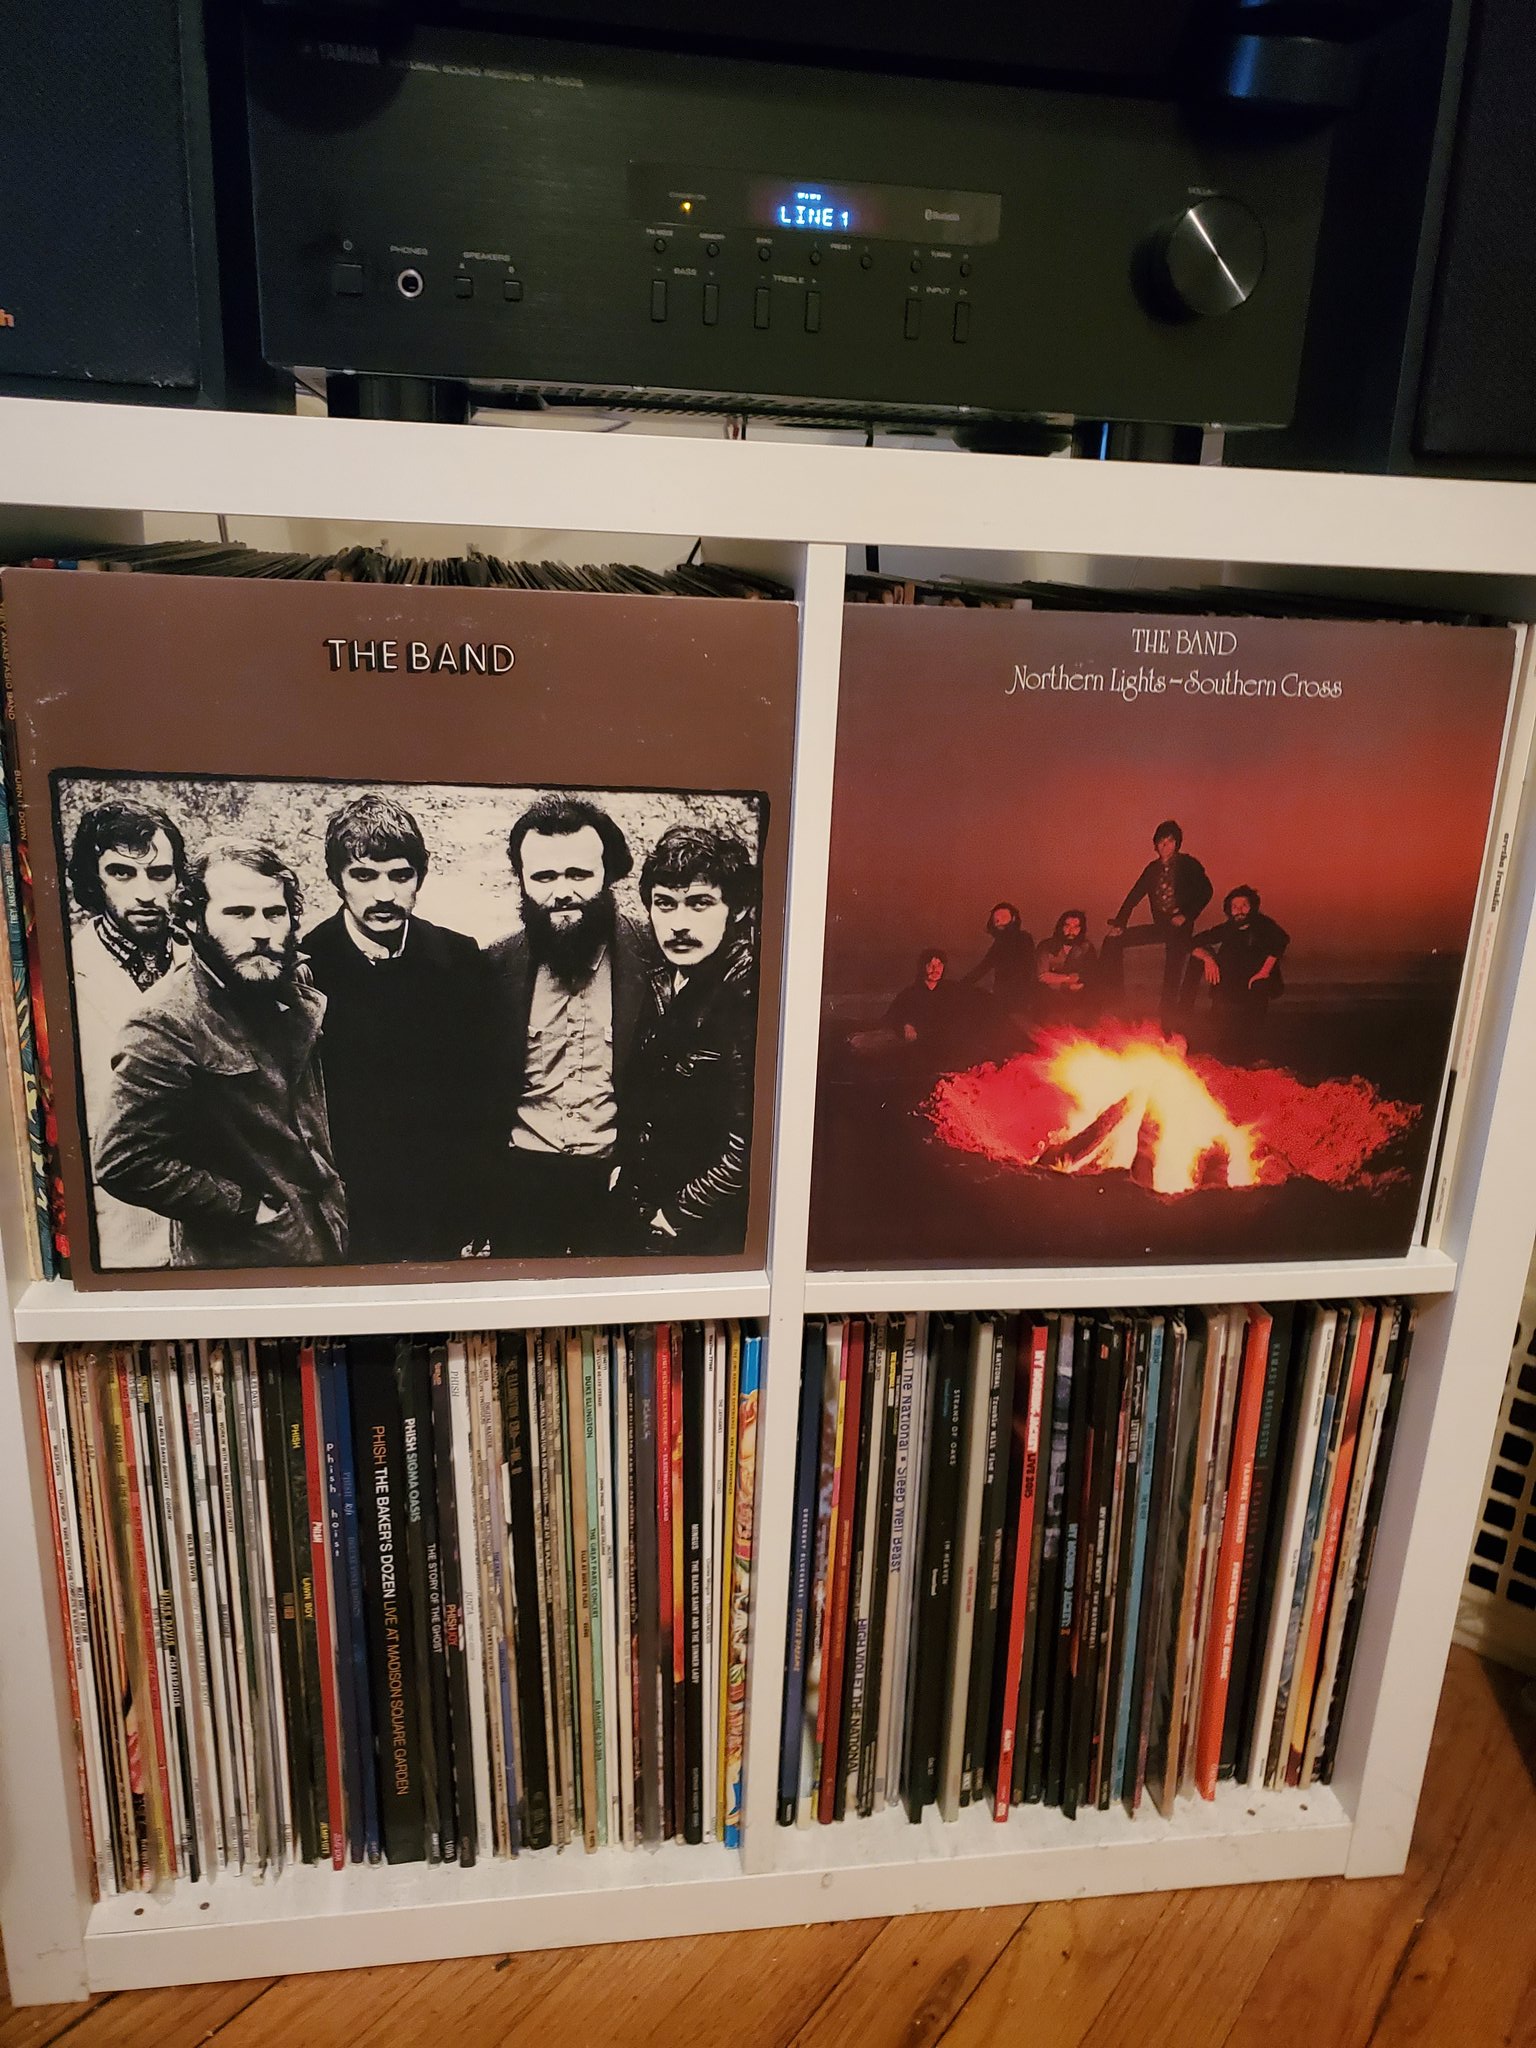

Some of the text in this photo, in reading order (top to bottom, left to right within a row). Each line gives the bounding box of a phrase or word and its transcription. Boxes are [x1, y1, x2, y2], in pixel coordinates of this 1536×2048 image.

[780, 205, 848, 228] LINE 1
[323, 638, 515, 676] THE BAND
[1132, 628, 1238, 656] THE BAND
[2, 632, 12, 689] ANASTASIO
[1005, 664, 1103, 695] Northern
[1281, 673, 1343, 698] Cross
[5, 692, 15, 720] BAND
[13, 770, 27, 840] BURN IT DOWN
[1491, 833, 1509, 912] aretha franklin
[902, 1368, 914, 1389] The
[993, 1353, 1002, 1389] NATIONAL
[1268, 1343, 1281, 1384] KAMASI
[202, 1376, 212, 1414] MILES DAVIS
[450, 1370, 460, 1397] PHISH
[251, 1391, 259, 1408] DAVIS
[584, 1375, 594, 1438] DUKE ELLINGTON
[951, 1388, 961, 1422] STRAND
[991, 1396, 1000, 1427] Trouble
[158, 1427, 166, 1445] MILES
[290, 1424, 300, 1448] PHISH
[899, 1396, 912, 1450] National
[950, 1425, 959, 1437] OF
[1129, 1419, 1140, 1441] LETTER
[1260, 1389, 1276, 1457] WASHINGTON
[160, 1446, 168, 1464] DAVIS
[220, 1447, 228, 1460] WITH
[949, 1442, 958, 1465] OAKS
[989, 1430, 997, 1449] Will
[403, 1417, 421, 1522] PHISH SIGMA OASIS
[1025, 1453, 1037, 1475] LIVE
[1127, 1450, 1138, 1462] YOU
[162, 1465, 170, 1489] QUINTET
[223, 1474, 231, 1490] MILES
[894, 1467, 908, 1503] Sleep
[1024, 1476, 1035, 1498] 2015
[224, 1492, 232, 1508] DAVIS
[1098, 1506, 1107, 1519] MY
[226, 1510, 234, 1533] QUINTET
[312, 1521, 323, 1543] PHISH
[800, 1508, 810, 1549] GREENSKY
[893, 1507, 906, 1533] Well
[1066, 1523, 1079, 1539] MY
[185, 1533, 197, 1582] MILES DAVIS
[890, 1537, 903, 1573] Beast
[941, 1552, 950, 1584] HEAVEN
[1063, 1541, 1078, 1588] MORNING
[1221, 1461, 1252, 1680] VAMPIRE WEEKEND FATHER OF THE BRIDE
[590, 1565, 598, 1585] PARIS
[300, 1578, 314, 1618] LAWN BOY
[370, 1425, 409, 1795] PHISH THE BAKER'S DOZEN LIVE AT MADISON SQUARE GARDEN
[427, 1543, 443, 1653] THE STORY OF THE GHOST
[465, 1591, 474, 1615] JUNTA
[591, 1587, 599, 1619] CONCERT
[690, 1524, 699, 1683] MINGUS THE BLACK SAINT AND THE SINNER LADY
[444, 1604, 459, 1646] PHISH JOY
[793, 1608, 804, 1637] STRESS
[169, 1655, 181, 1707] CHAMPIONS
[845, 1618, 868, 1775] HIGH VIOLET THE NATIONAL
